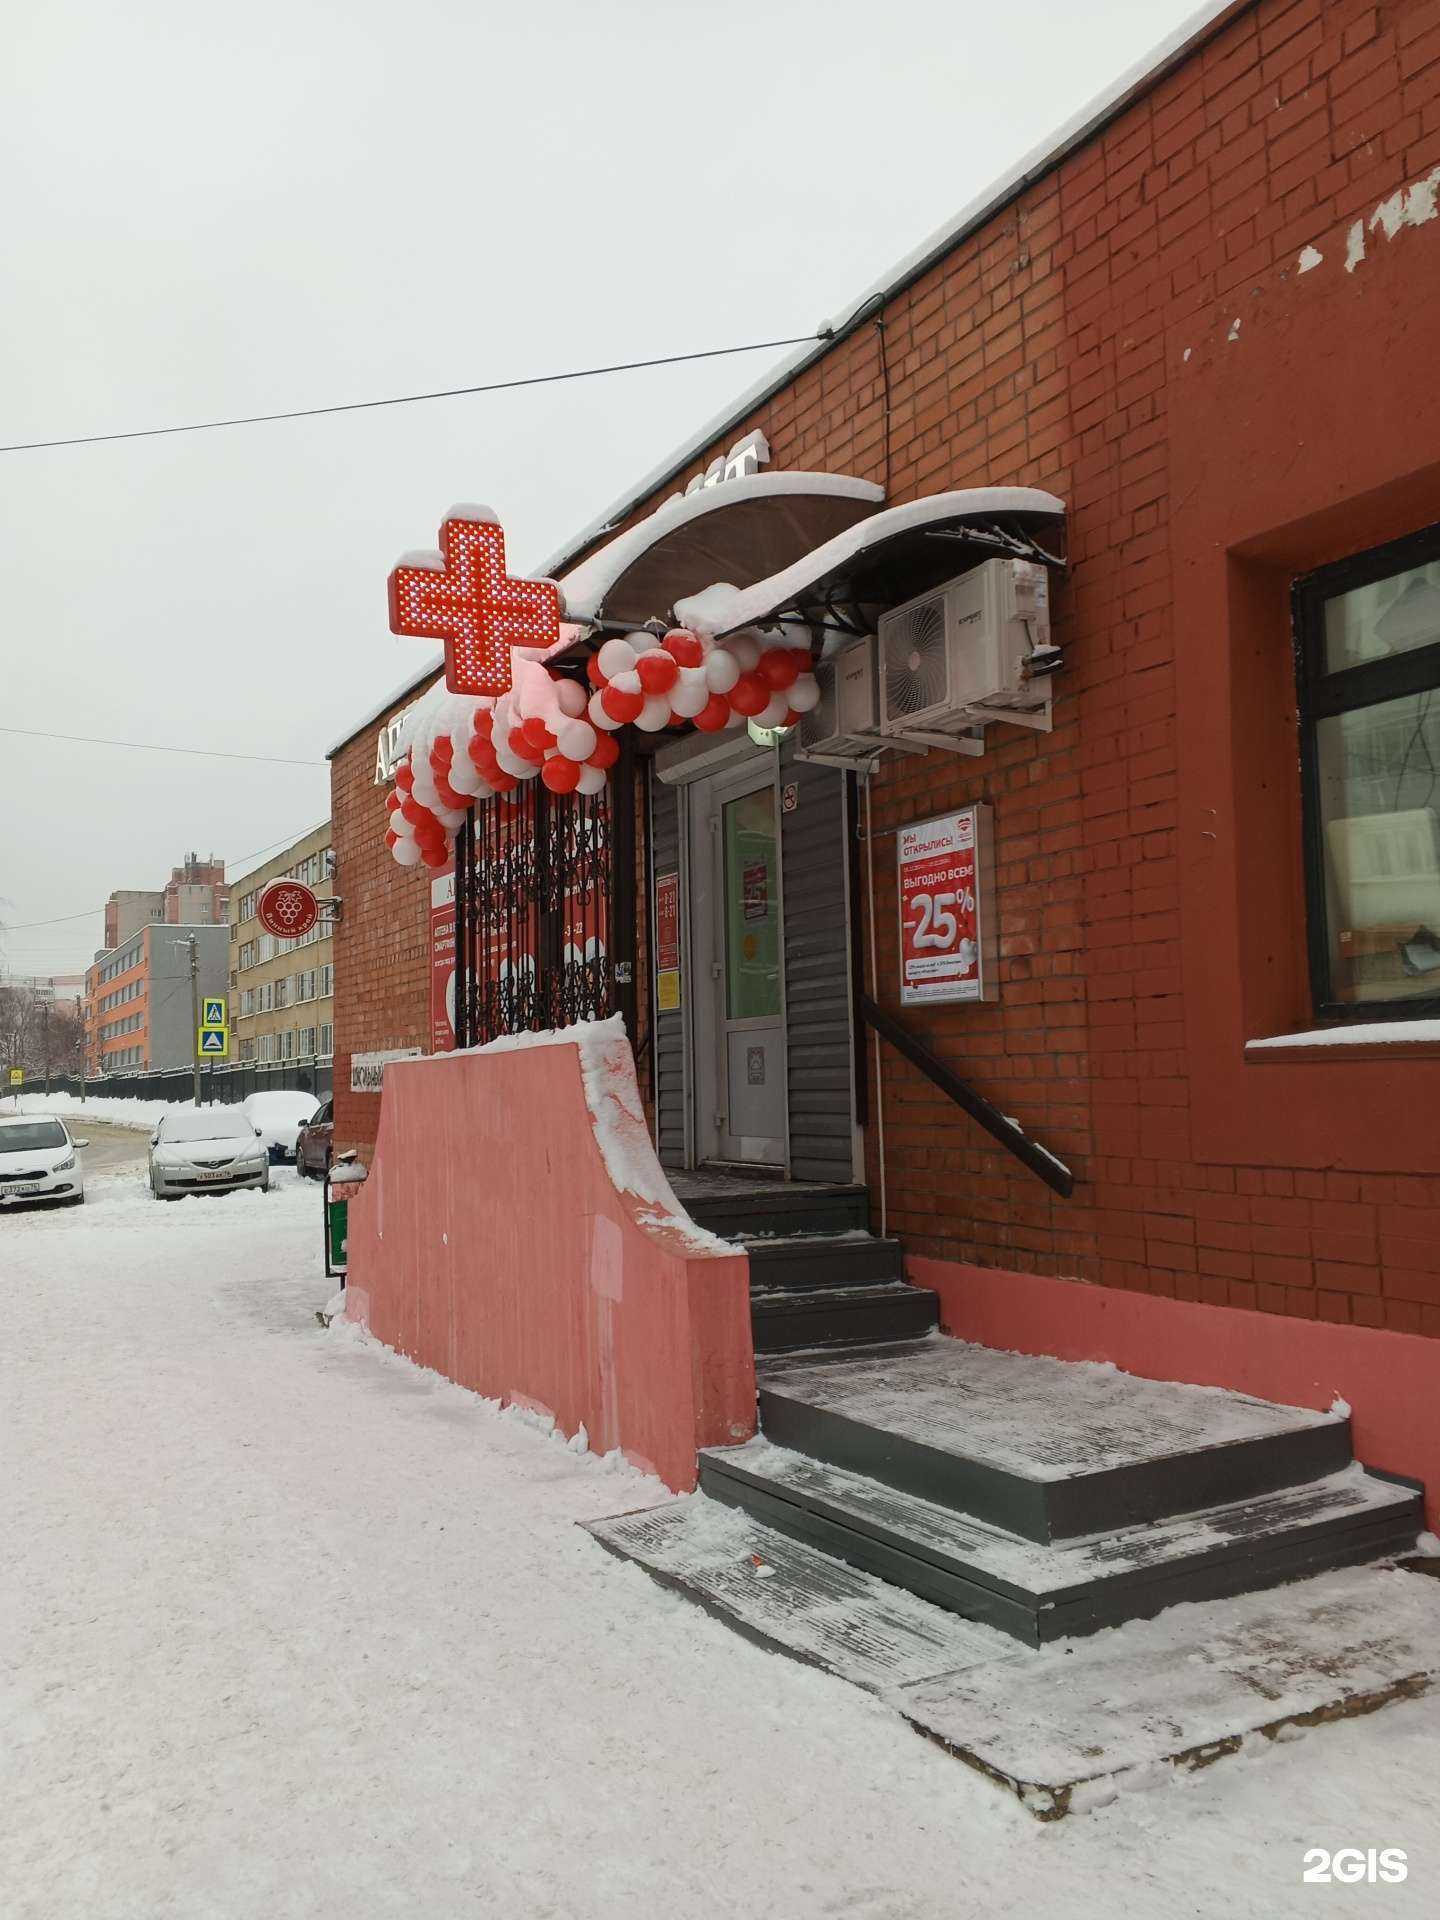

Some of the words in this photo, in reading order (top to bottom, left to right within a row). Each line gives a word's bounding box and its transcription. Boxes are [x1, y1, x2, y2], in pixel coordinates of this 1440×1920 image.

[903, 834, 917, 846] МЫ
[904, 870, 947, 889] ВЫГОДНО
[903, 887, 975, 949] -25%
